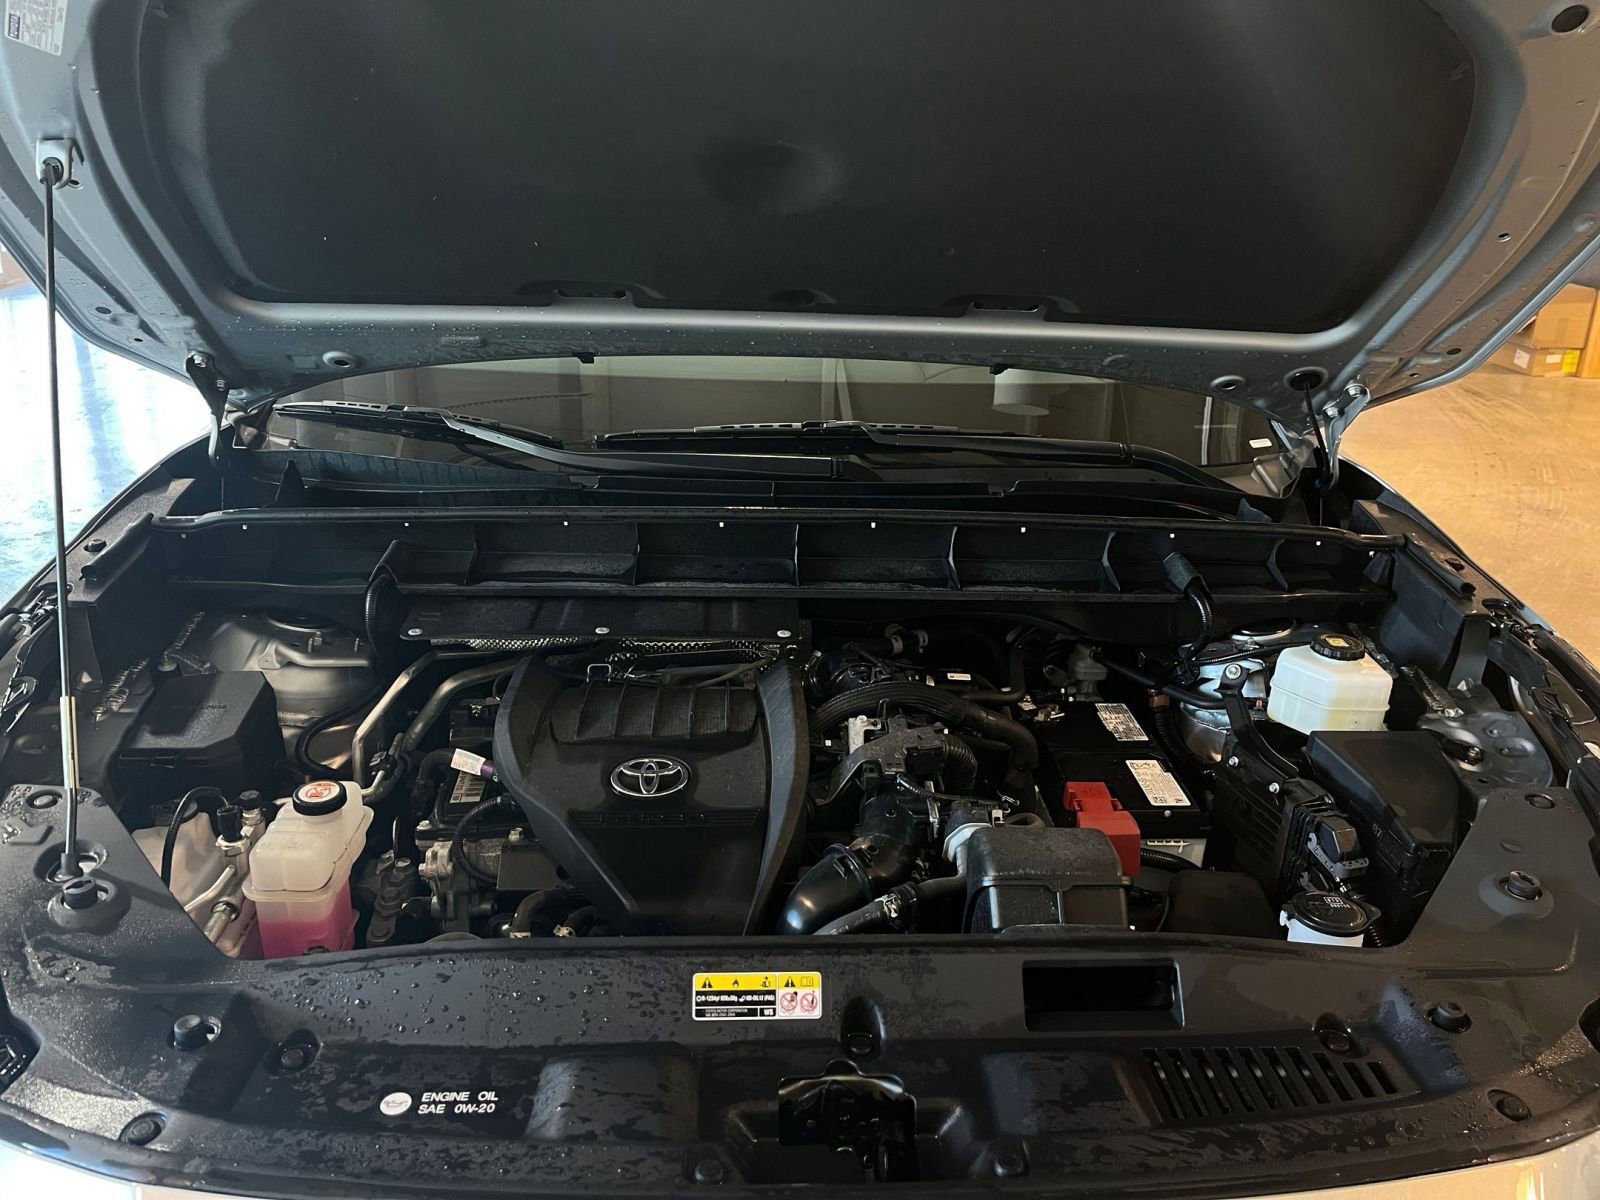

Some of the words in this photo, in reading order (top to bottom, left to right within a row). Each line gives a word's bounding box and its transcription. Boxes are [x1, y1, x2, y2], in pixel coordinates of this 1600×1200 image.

[421, 1092, 470, 1102] ENGINE
[478, 1091, 498, 1101] OIL
[418, 1104, 446, 1114] SAE
[454, 1103, 495, 1113] 0W-20
